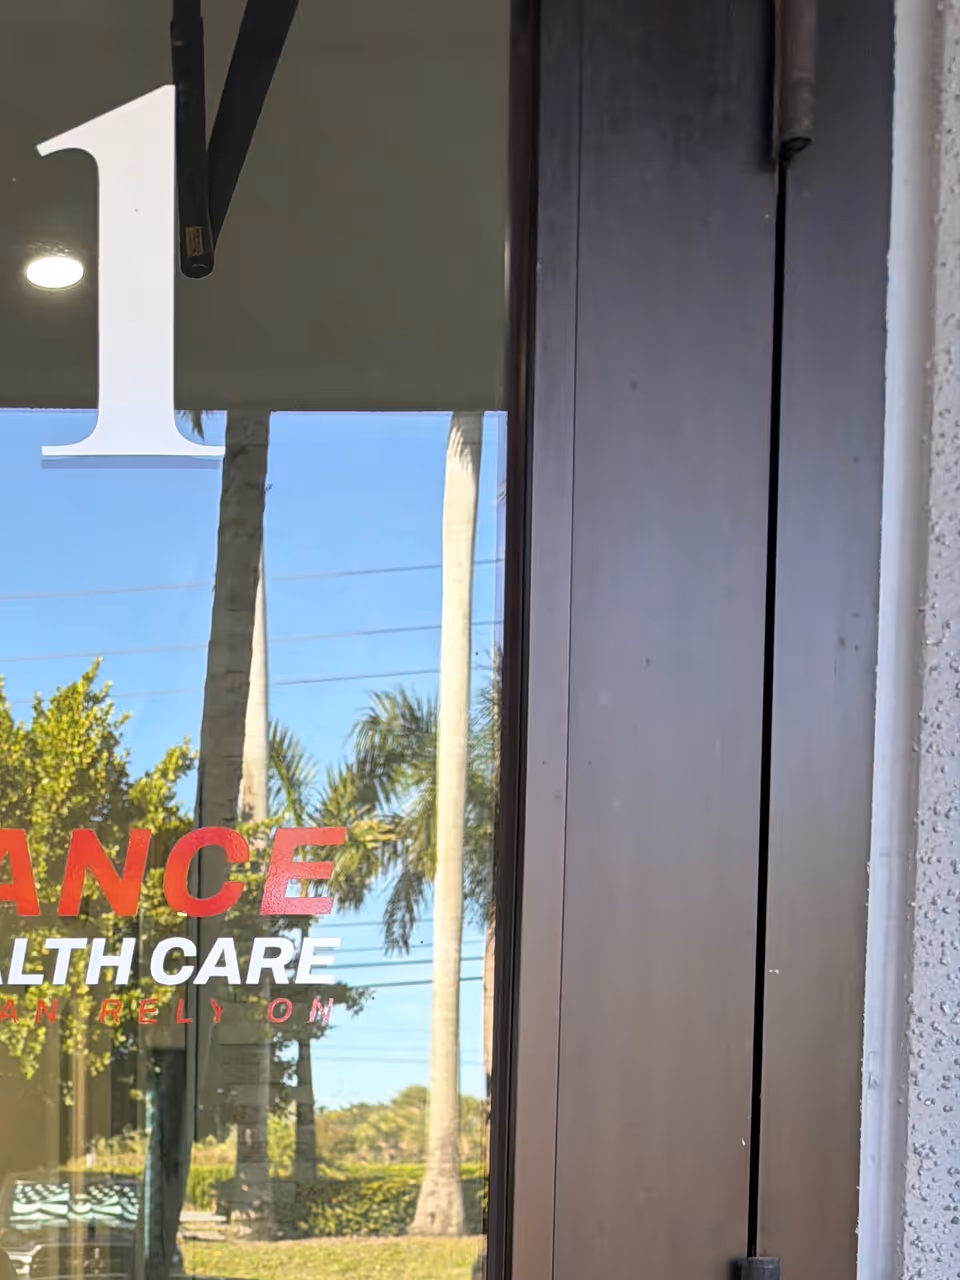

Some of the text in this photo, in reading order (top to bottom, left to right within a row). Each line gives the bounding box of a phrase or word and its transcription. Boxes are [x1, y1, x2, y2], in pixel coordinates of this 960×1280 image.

[148, 937, 341, 986] CARE
[98, 997, 224, 1024] RELY
[266, 997, 334, 1024] ON
